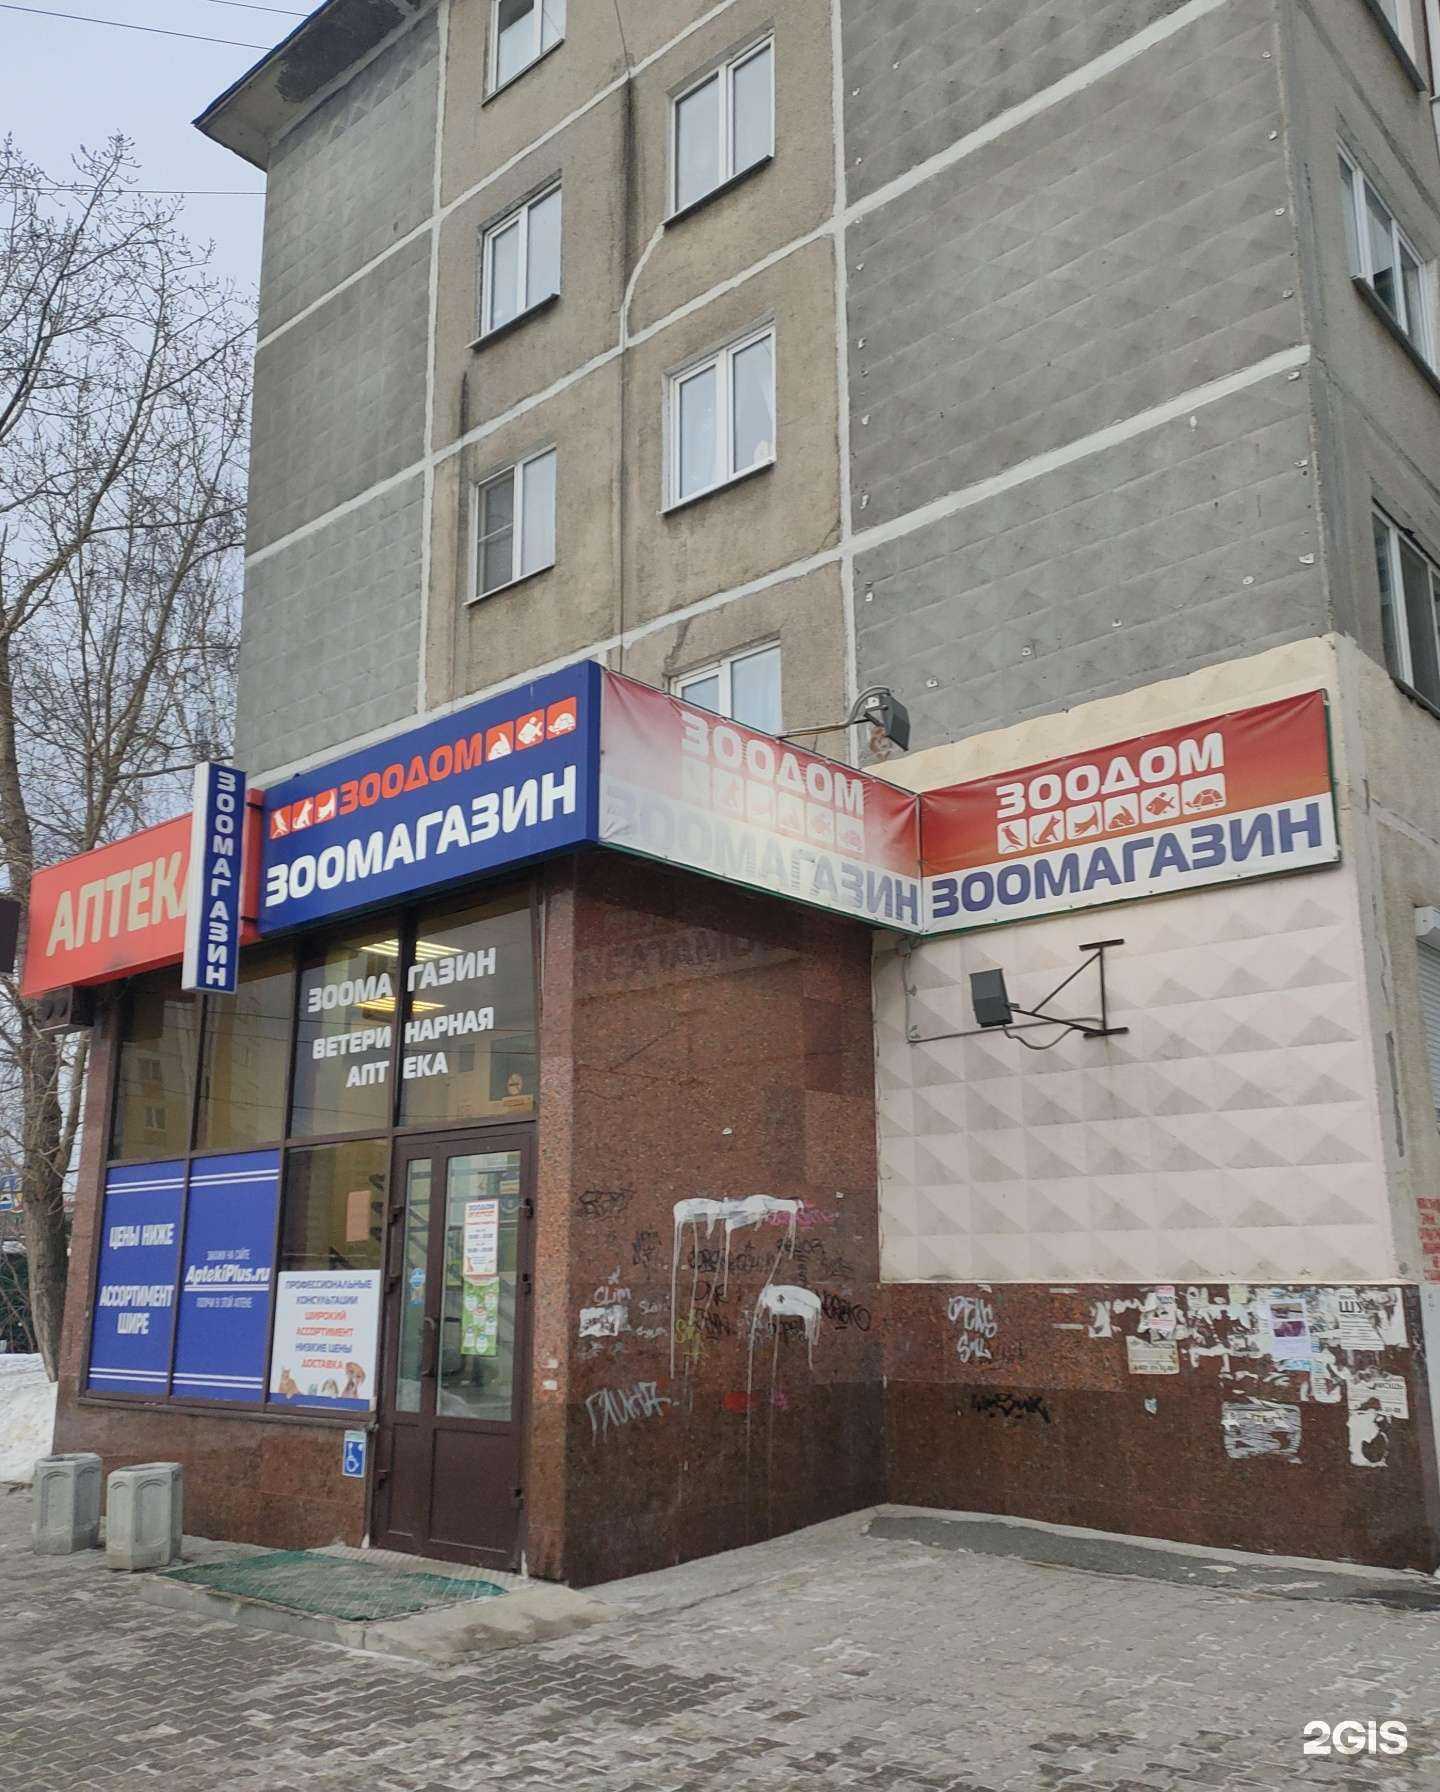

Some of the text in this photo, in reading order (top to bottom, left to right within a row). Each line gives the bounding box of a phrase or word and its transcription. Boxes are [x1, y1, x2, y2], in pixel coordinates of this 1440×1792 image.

[337, 732, 483, 815] ЗООДОМ
[681, 711, 864, 817] ЗООДОМ
[996, 732, 1224, 819] ЗООДОМ
[265, 764, 577, 908] ЗООМАГАЗИН
[932, 802, 1323, 918] ЗООМАГАЗИН
[206, 771, 236, 986] ЗООМАГАЗИН
[109, 1223, 175, 1250] ЦЕНЫ НИЖЕ
[185, 1264, 271, 1285] AptekiPlus.ru
[100, 1285, 175, 1307] АССОРТИМЕНТ
[117, 1312, 149, 1335] ШИРЕ
[328, 1343, 353, 1354] ЦЕНЫ
